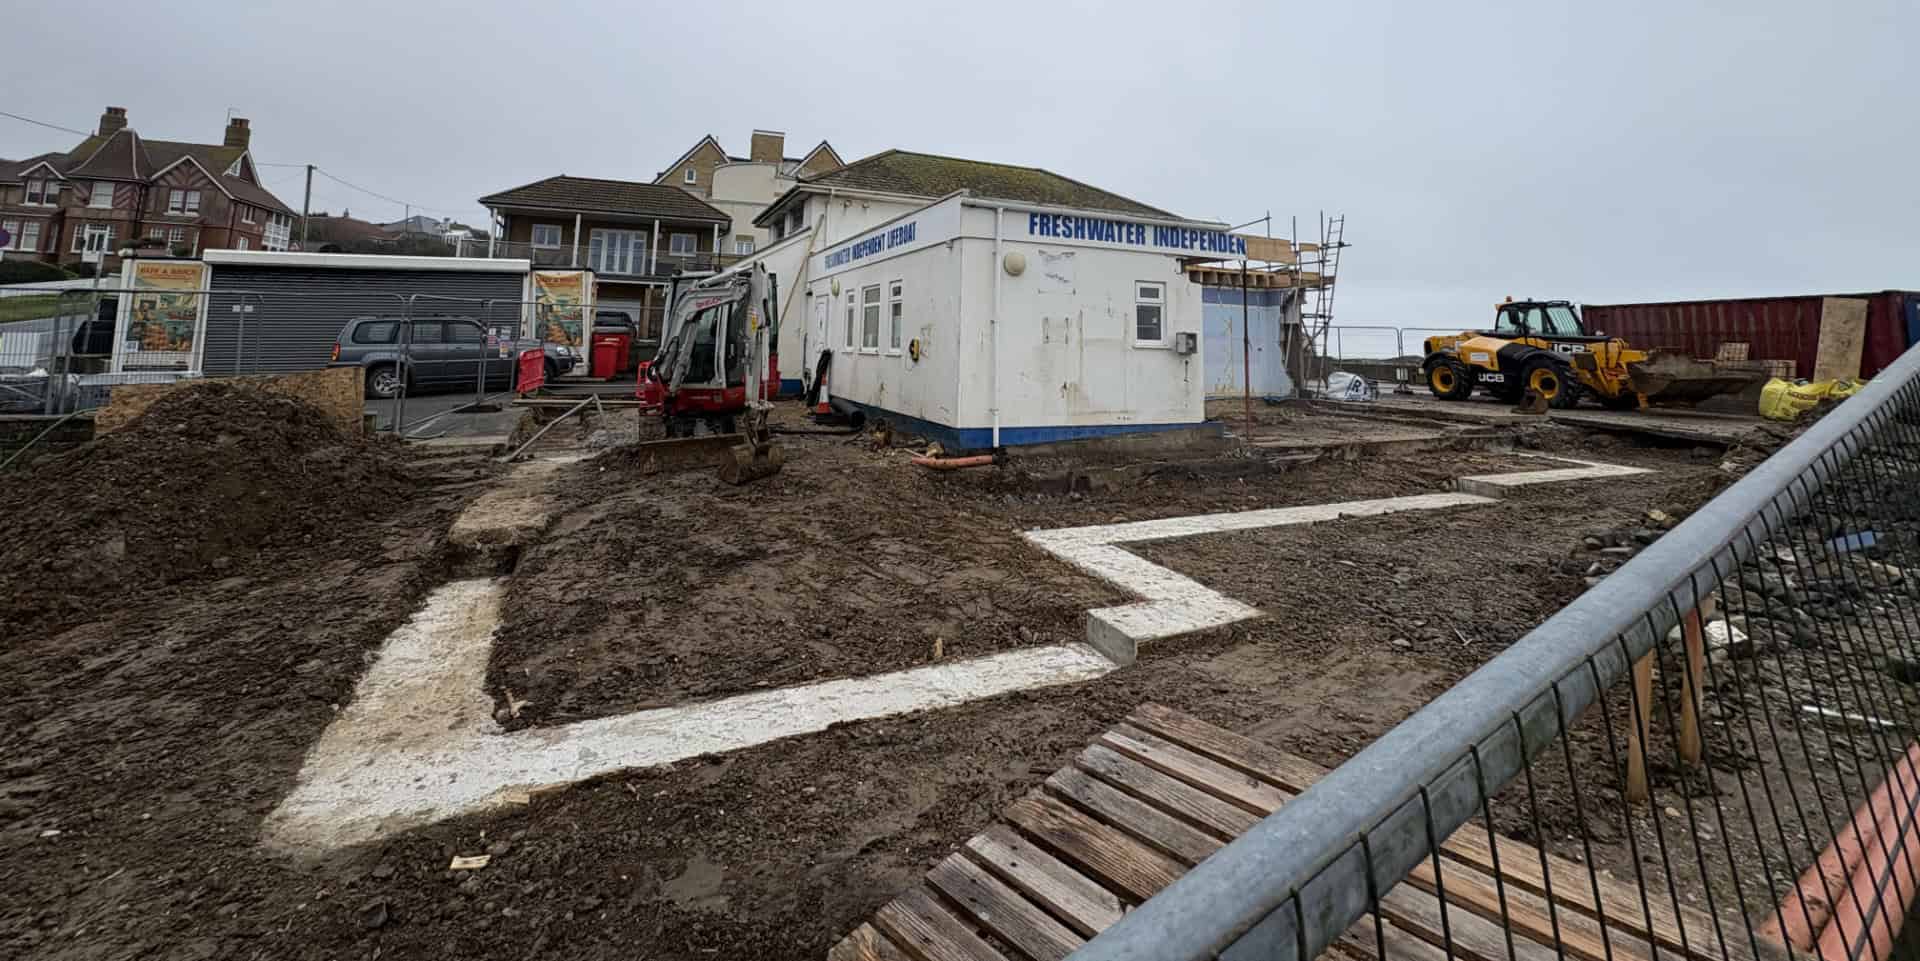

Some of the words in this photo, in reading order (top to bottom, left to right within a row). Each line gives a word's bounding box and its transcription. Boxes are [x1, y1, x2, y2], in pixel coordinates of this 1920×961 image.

[887, 222, 916, 249] LIFEBOAT
[1028, 212, 1146, 245] FRESHWATER
[1152, 225, 1247, 255] INDEPENDEN
[1478, 372, 1505, 383] JCB
